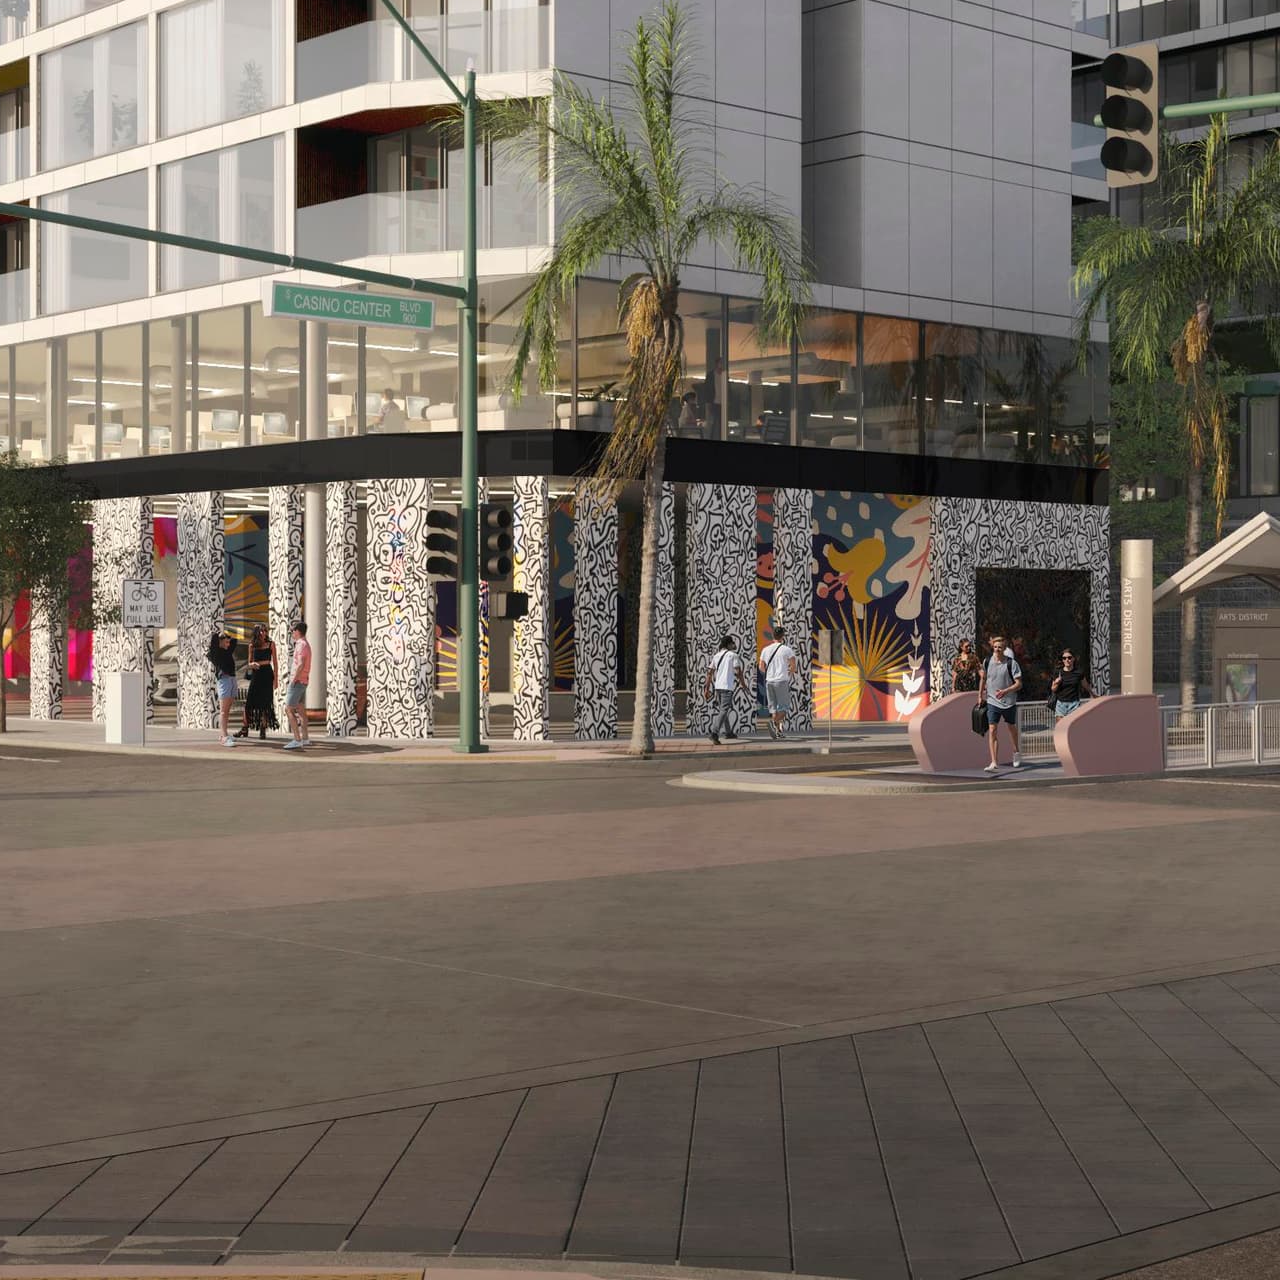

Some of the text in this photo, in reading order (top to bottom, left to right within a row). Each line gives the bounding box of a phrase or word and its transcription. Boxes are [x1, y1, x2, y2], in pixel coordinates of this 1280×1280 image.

[293, 293, 392, 319] CASINO CENTER
[399, 300, 422, 314] BLVD
[1123, 578, 1133, 657] ARTS DISTRICT
[1218, 613, 1236, 621] ARTS
[1238, 613, 1269, 621] DISTRICT
